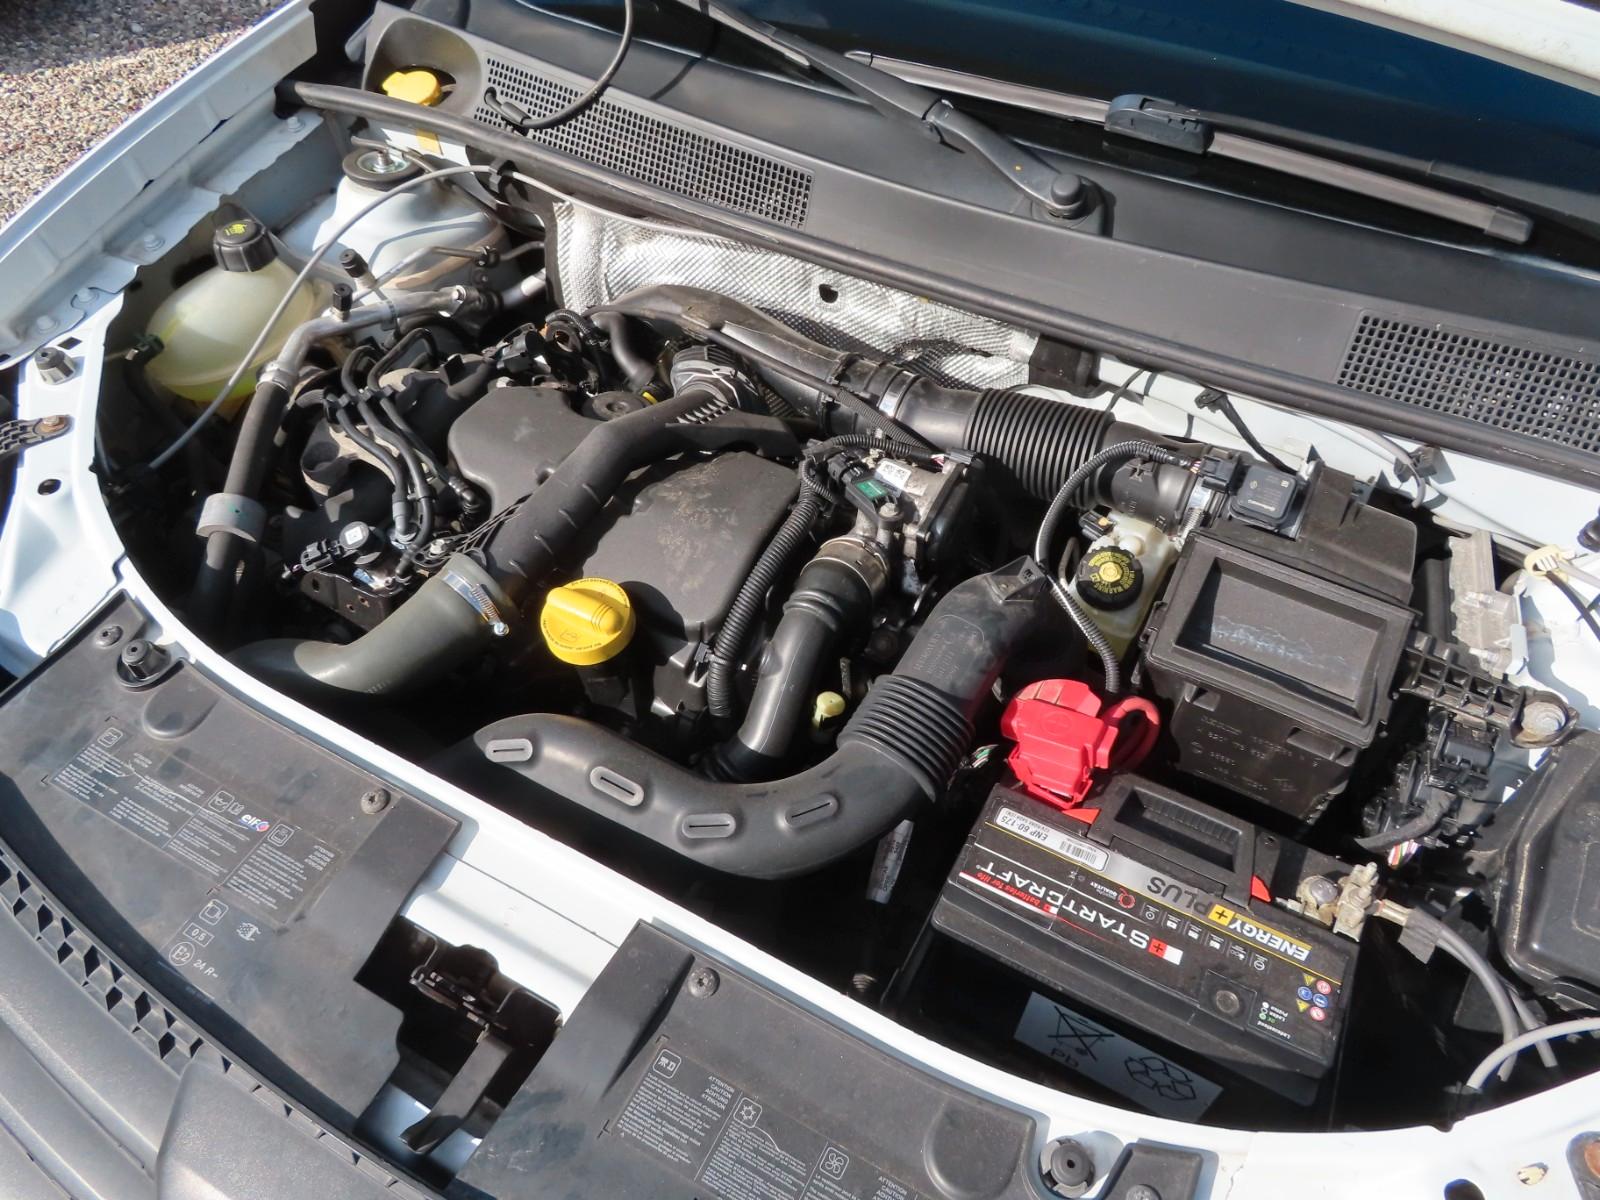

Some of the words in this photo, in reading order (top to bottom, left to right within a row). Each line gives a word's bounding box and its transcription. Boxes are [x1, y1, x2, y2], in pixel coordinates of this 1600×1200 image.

[241, 813, 262, 830] elf
[1000, 815, 1029, 832] 60-175
[1030, 829, 1048, 840] ENP
[976, 871, 991, 882] life
[991, 877, 1004, 887] for
[1005, 883, 1040, 905] batteries
[1145, 875, 1212, 915] PLUS
[980, 860, 1150, 949] STARTCRAFT
[1228, 917, 1310, 960] ENERGY
[1050, 1047, 1079, 1068] Pb
[707, 1075, 735, 1093] ATTENTION
[710, 1084, 732, 1099] CAUTION
[878, 1176, 907, 1195] ATTENTION
